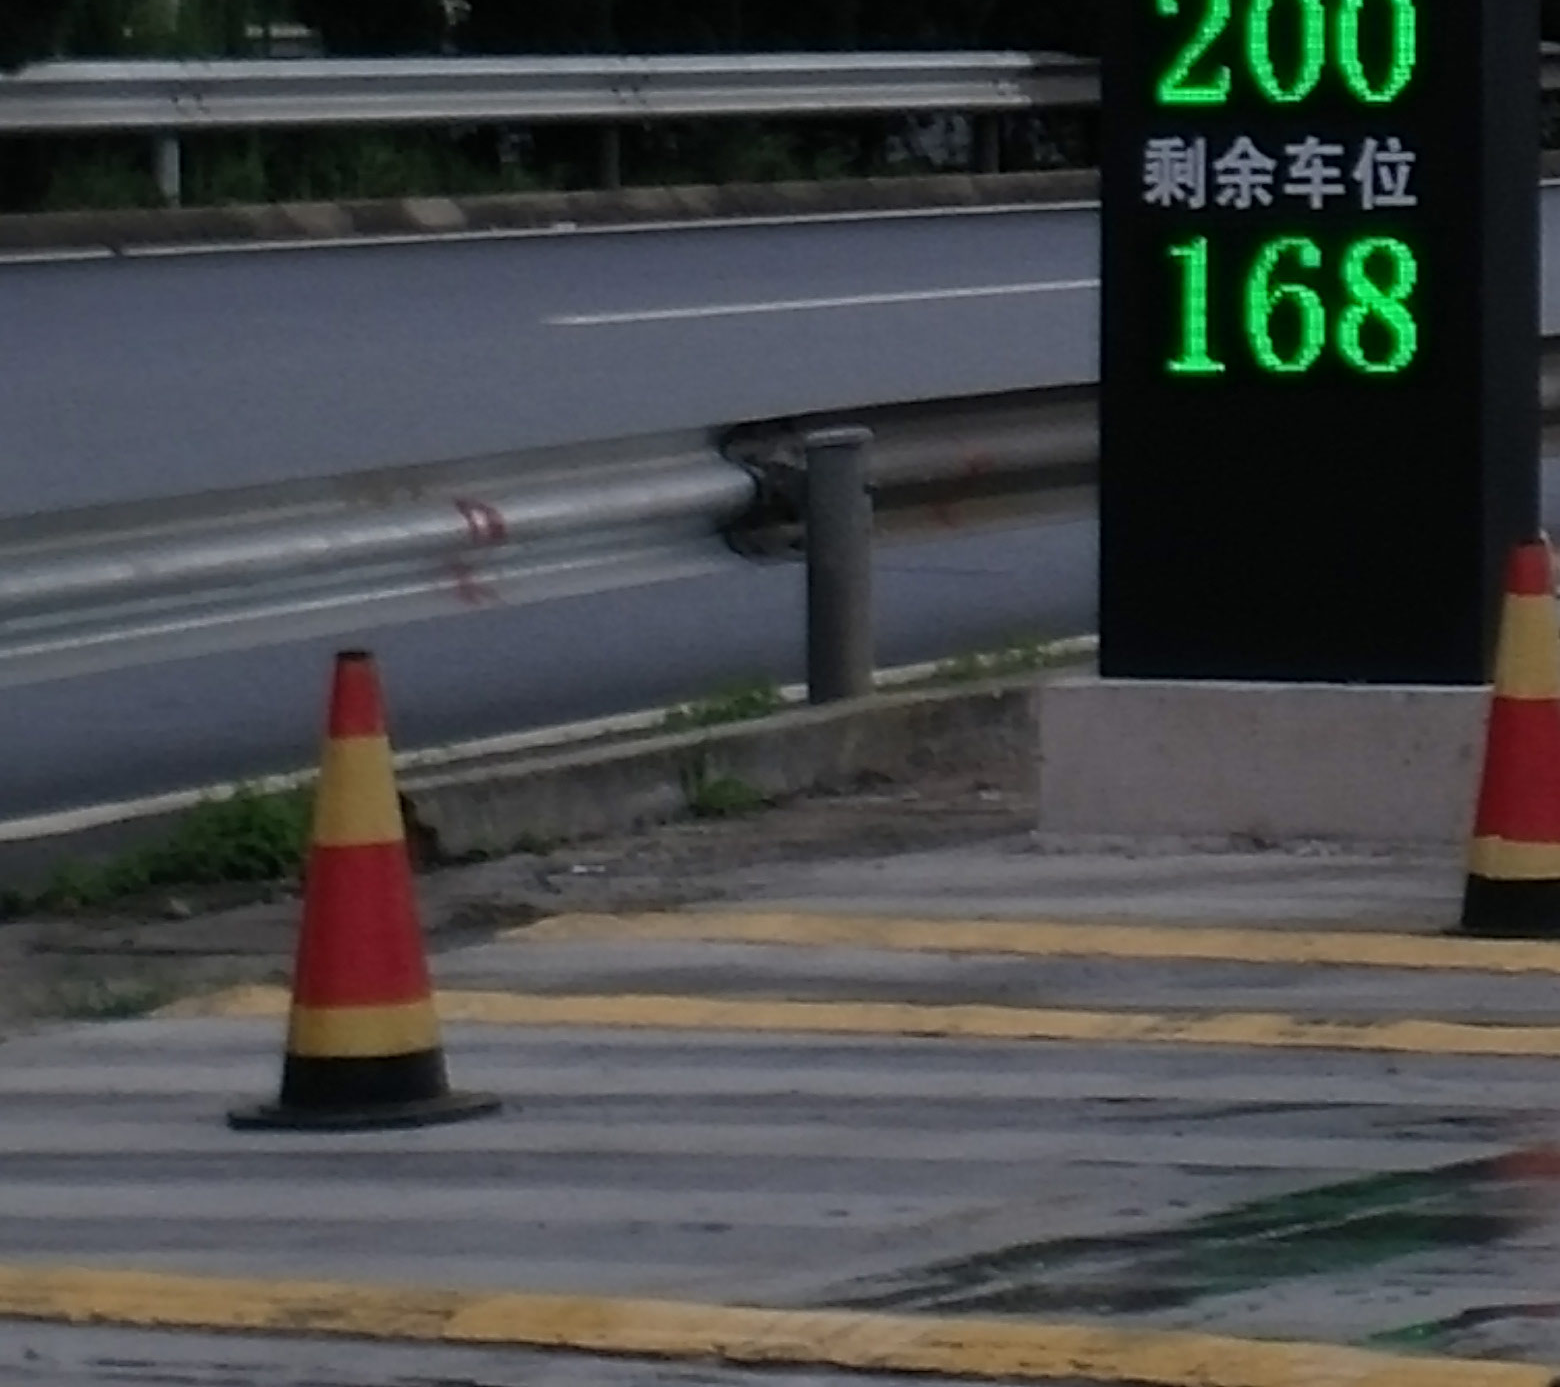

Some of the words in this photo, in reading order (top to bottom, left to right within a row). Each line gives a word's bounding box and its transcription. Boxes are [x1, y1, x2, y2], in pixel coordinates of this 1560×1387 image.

[1142, 136, 1418, 211] 剩余车位
[1165, 235, 1418, 374] 168
